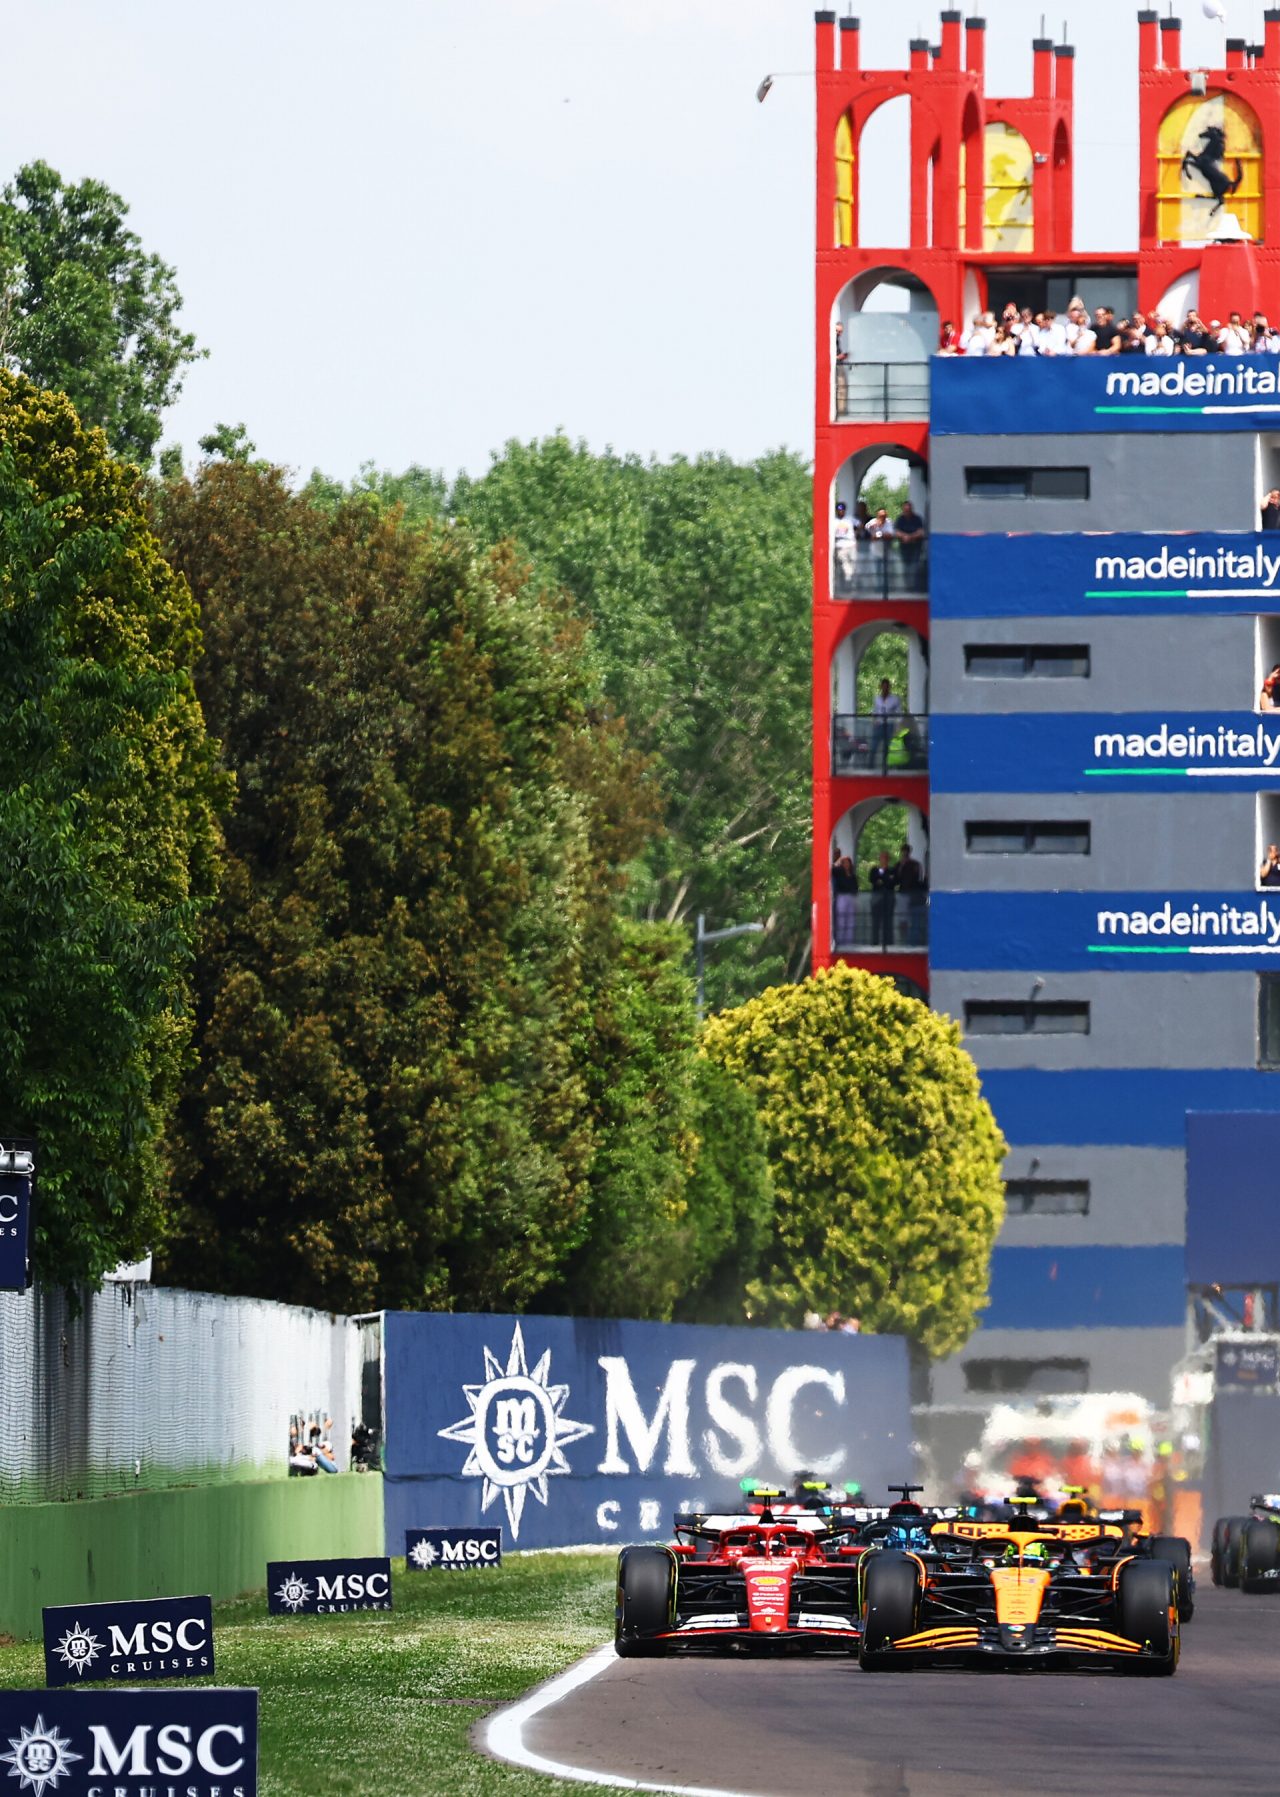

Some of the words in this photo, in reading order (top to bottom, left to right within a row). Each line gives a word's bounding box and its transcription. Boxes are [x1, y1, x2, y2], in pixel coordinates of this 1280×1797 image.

[598, 1356, 848, 1479] MSC
[441, 1539, 498, 1561] MSC
[315, 1573, 389, 1600] MSC
[107, 1618, 206, 1657] MSC
[110, 1656, 209, 1673] CRUISES
[88, 1724, 245, 1776] MSC
